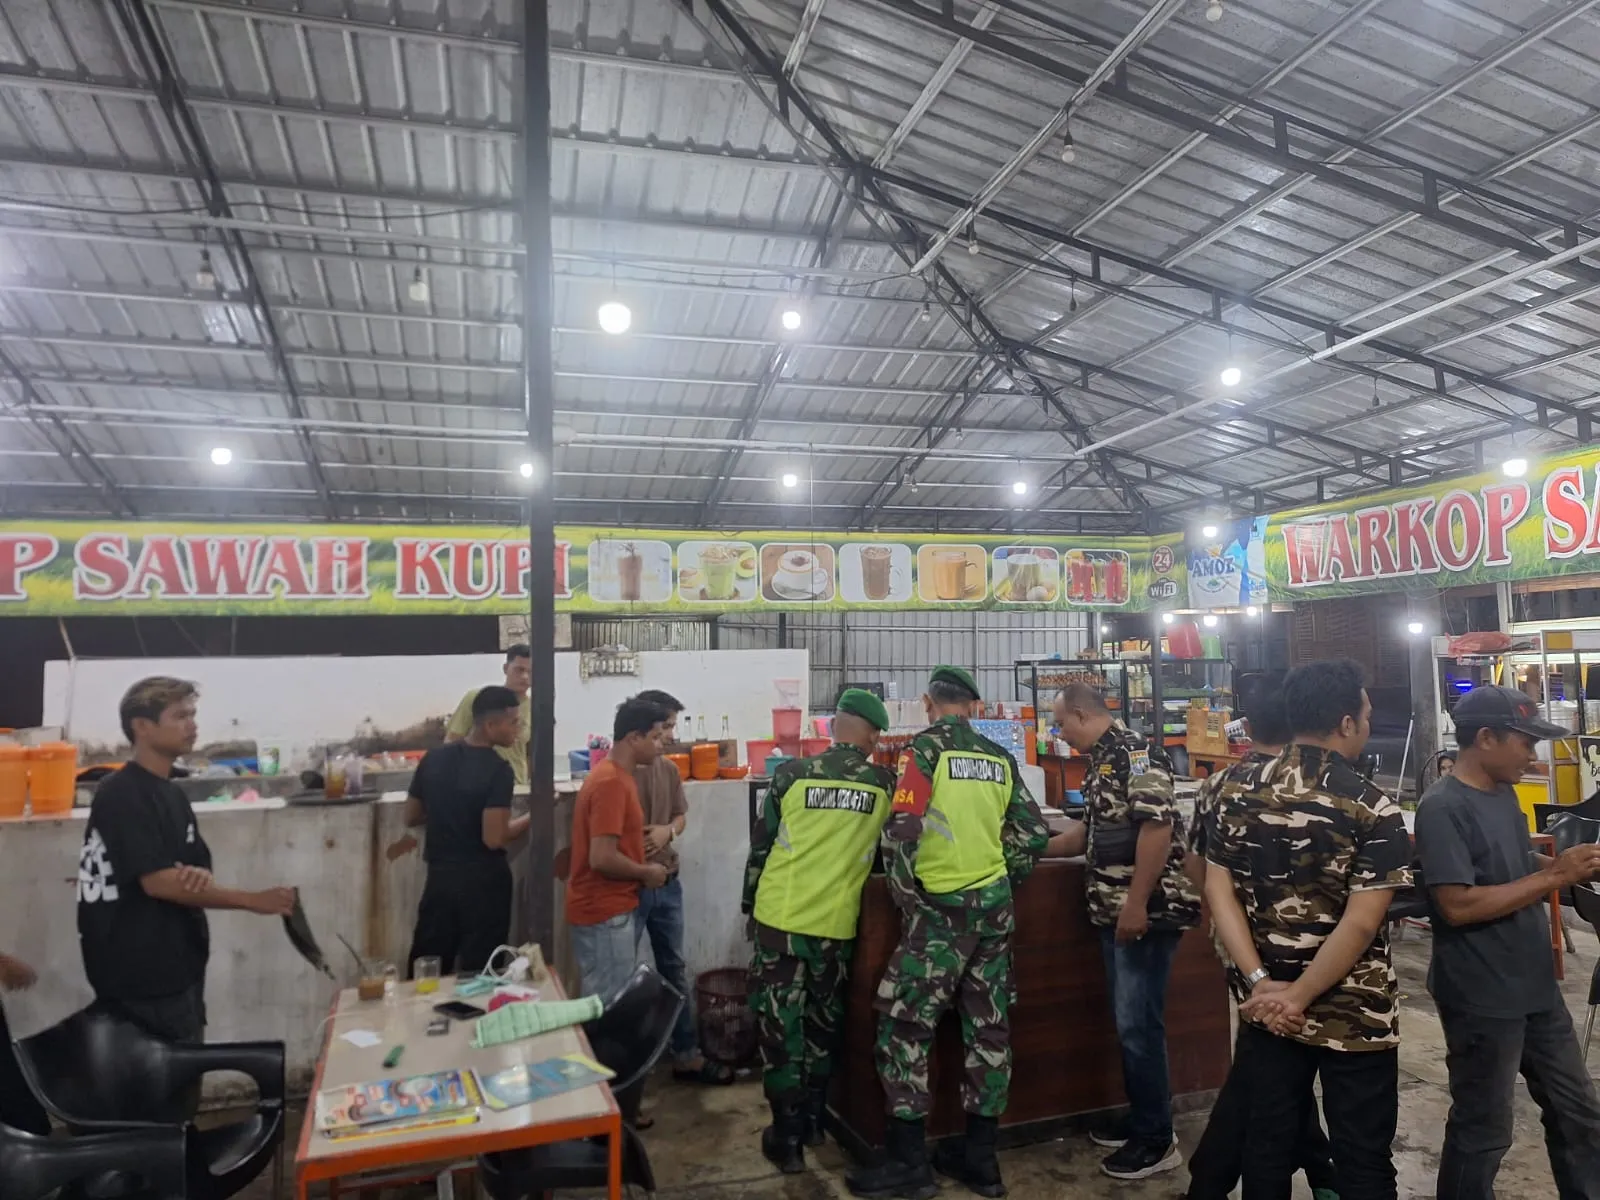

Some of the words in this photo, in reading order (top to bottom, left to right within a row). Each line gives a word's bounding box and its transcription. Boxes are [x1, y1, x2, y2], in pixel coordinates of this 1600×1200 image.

[73, 532, 370, 600] SAWAH
[1154, 553, 1171, 567] 24
[1283, 481, 1531, 587] WARKOP
